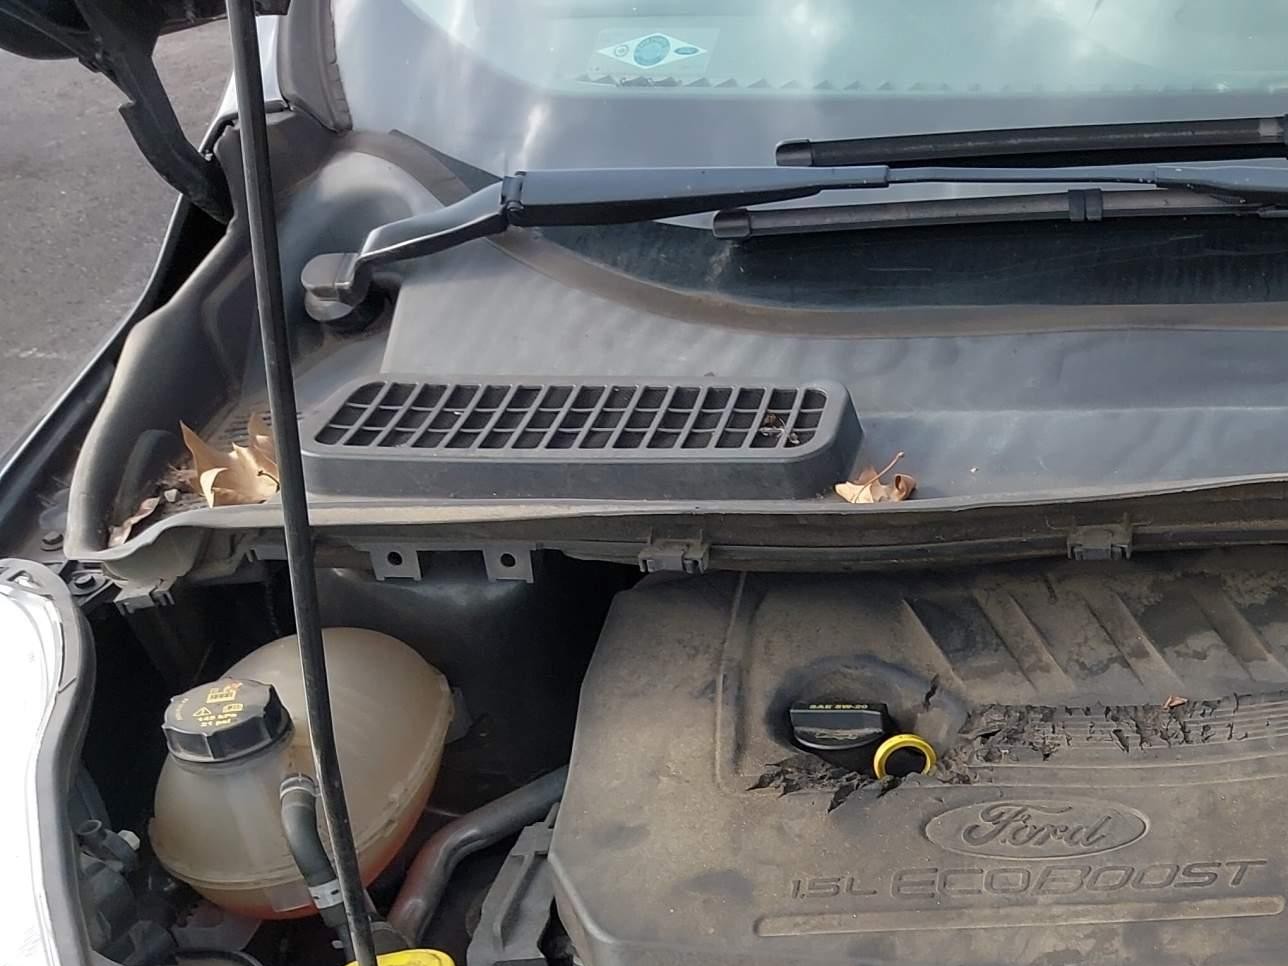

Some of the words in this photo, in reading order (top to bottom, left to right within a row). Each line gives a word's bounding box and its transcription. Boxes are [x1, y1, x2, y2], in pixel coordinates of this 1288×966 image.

[960, 801, 1112, 849] Ford
[791, 877, 878, 900] 1.5L
[891, 858, 1268, 899] ECOBOOST
